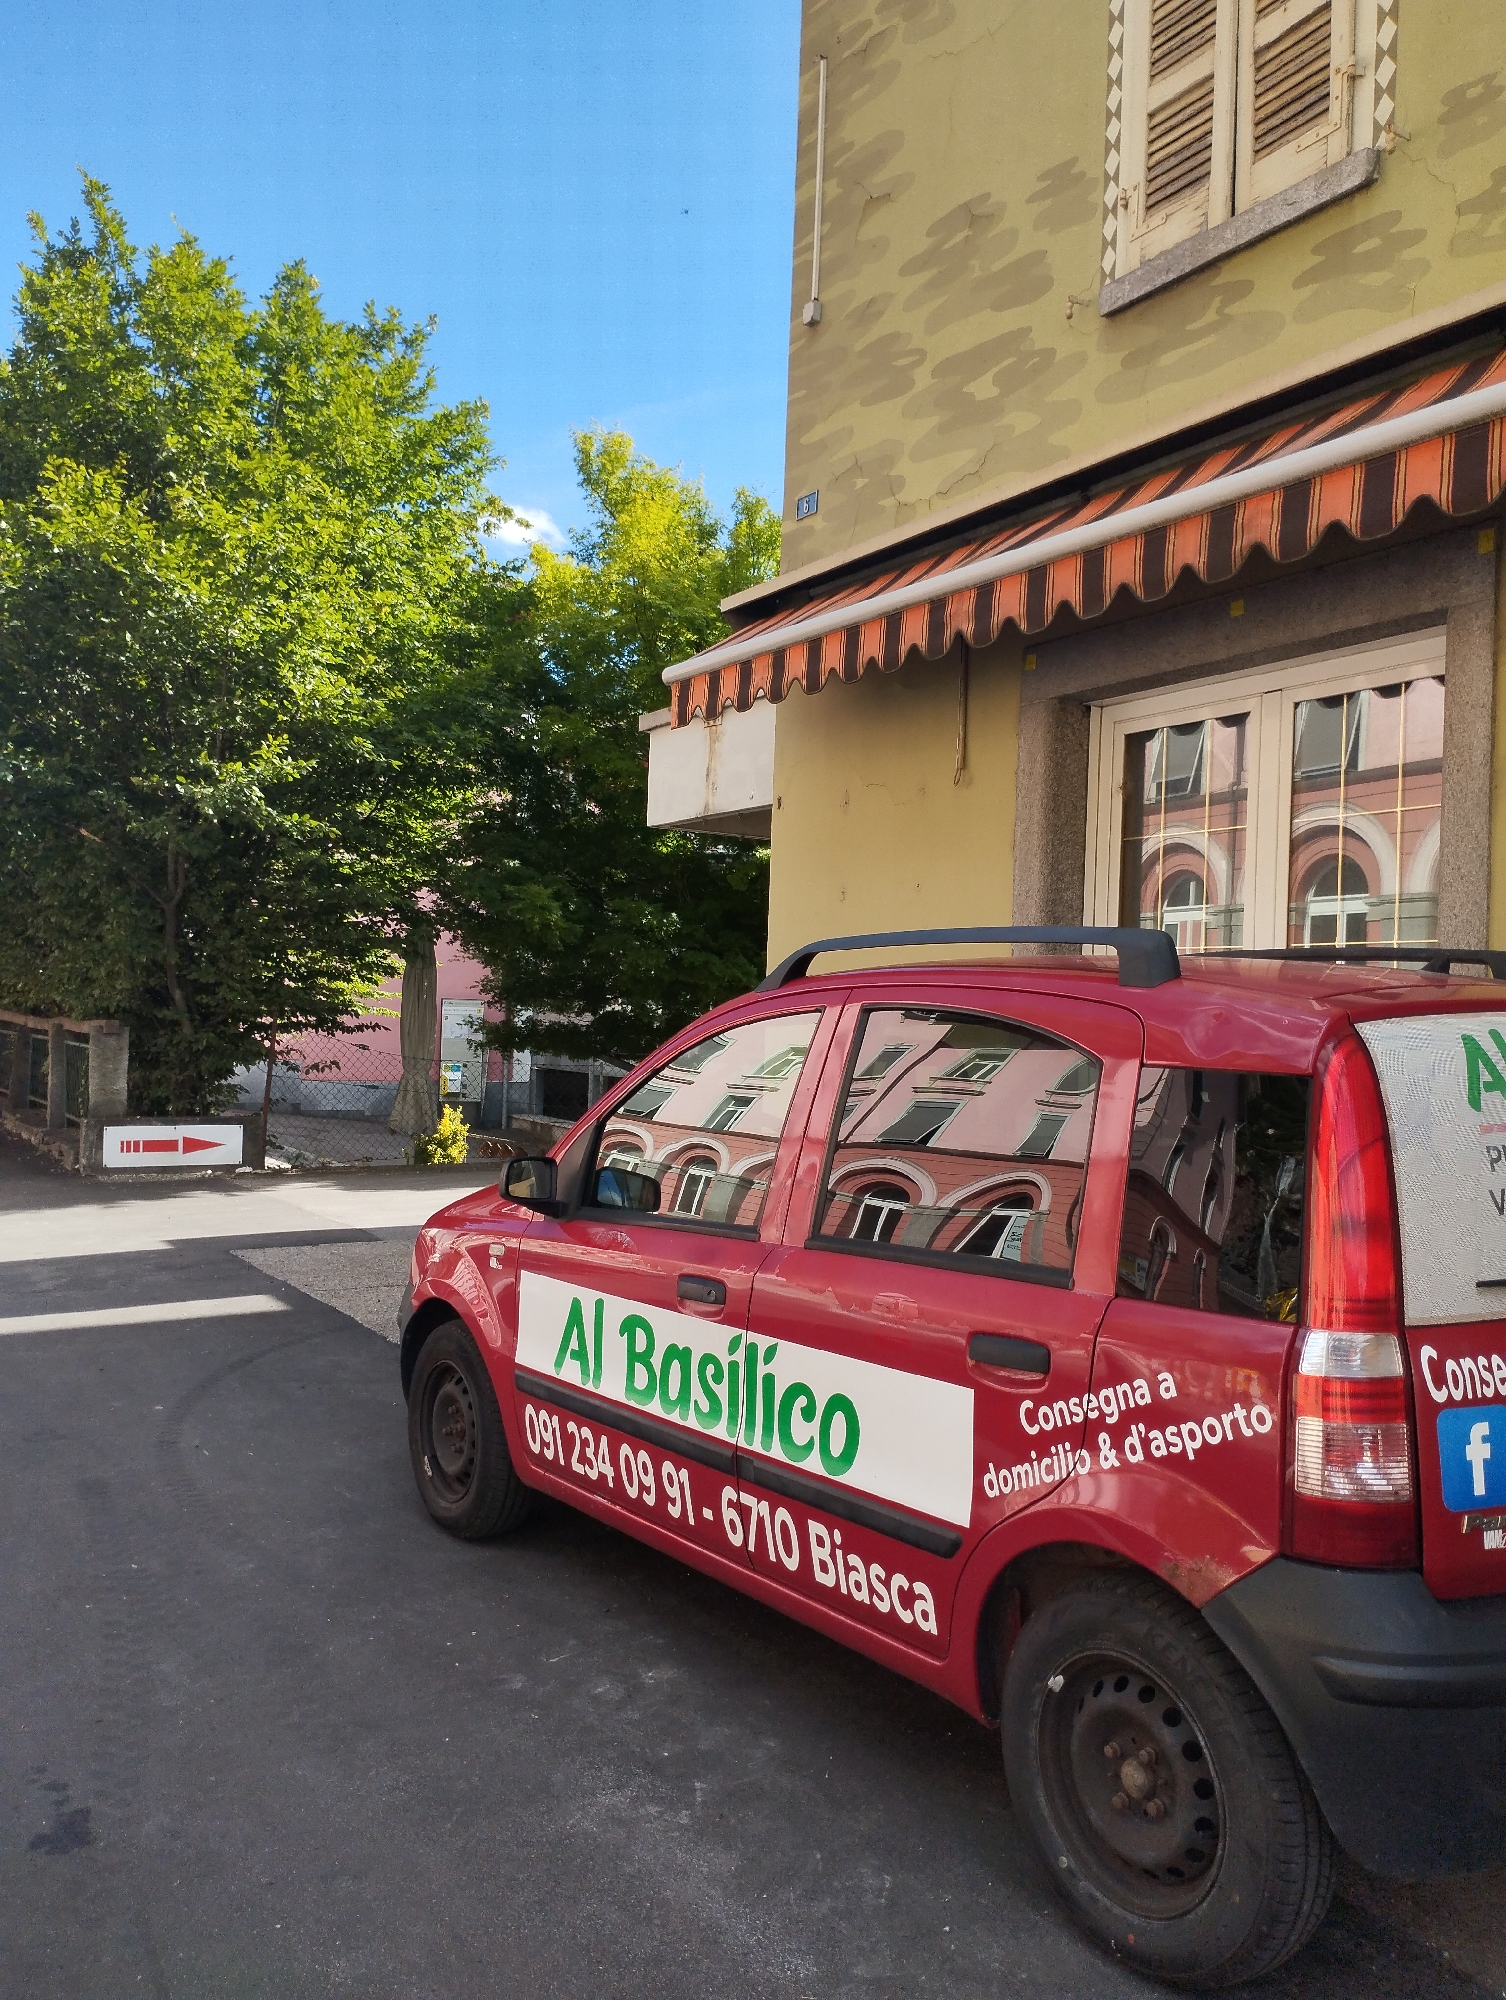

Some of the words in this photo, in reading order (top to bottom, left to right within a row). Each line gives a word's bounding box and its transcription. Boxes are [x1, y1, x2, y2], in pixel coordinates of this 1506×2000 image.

[803, 497, 810, 513] 6
[554, 1297, 604, 1389] Al
[1020, 1377, 1151, 1434] Consegna
[1158, 1372, 1177, 1399] a
[983, 1441, 1090, 1498] domicilio
[1098, 1432, 1120, 1469] &
[1124, 1402, 1273, 1463] d'asporto
[1466, 1421, 1491, 1496] f
[525, 1403, 564, 1466] 091
[567, 1421, 613, 1487] 234
[620, 1444, 655, 1506] 09
[662, 1460, 695, 1525] 91
[702, 1506, 714, 1521] -
[721, 1486, 799, 1571] 6710
[808, 1519, 937, 1635] Biasca
